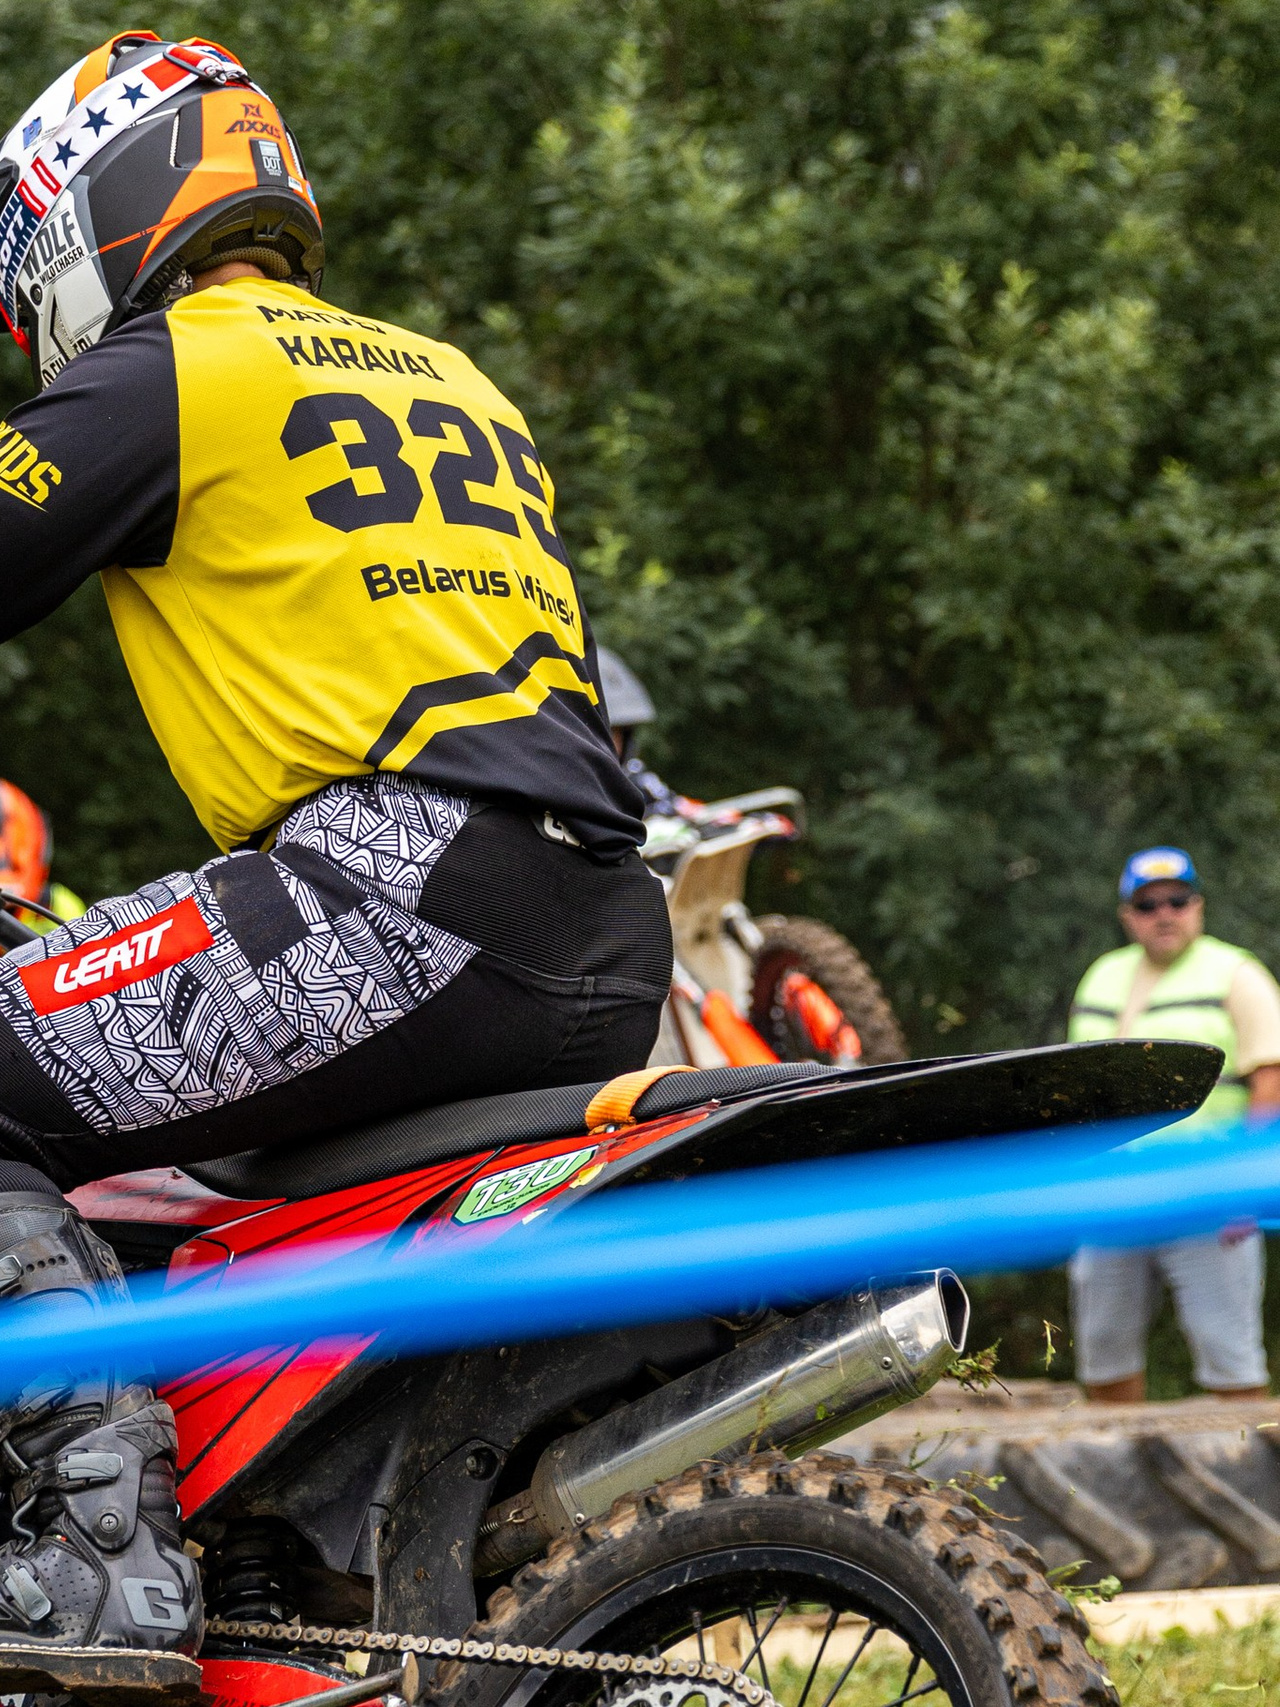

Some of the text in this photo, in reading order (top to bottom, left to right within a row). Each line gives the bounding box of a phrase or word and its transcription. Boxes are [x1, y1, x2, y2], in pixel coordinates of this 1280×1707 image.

[224, 119, 282, 140] AXXIS
[261, 156, 282, 170] DOT
[22, 210, 75, 281] WOLF
[39, 246, 86, 286] WILD CHASER
[276, 335, 446, 382] KARAVAI
[279, 392, 570, 569] 325
[360, 559, 511, 602] Belarus
[53, 918, 173, 994] LEATT
[470, 1150, 585, 1216] 130
